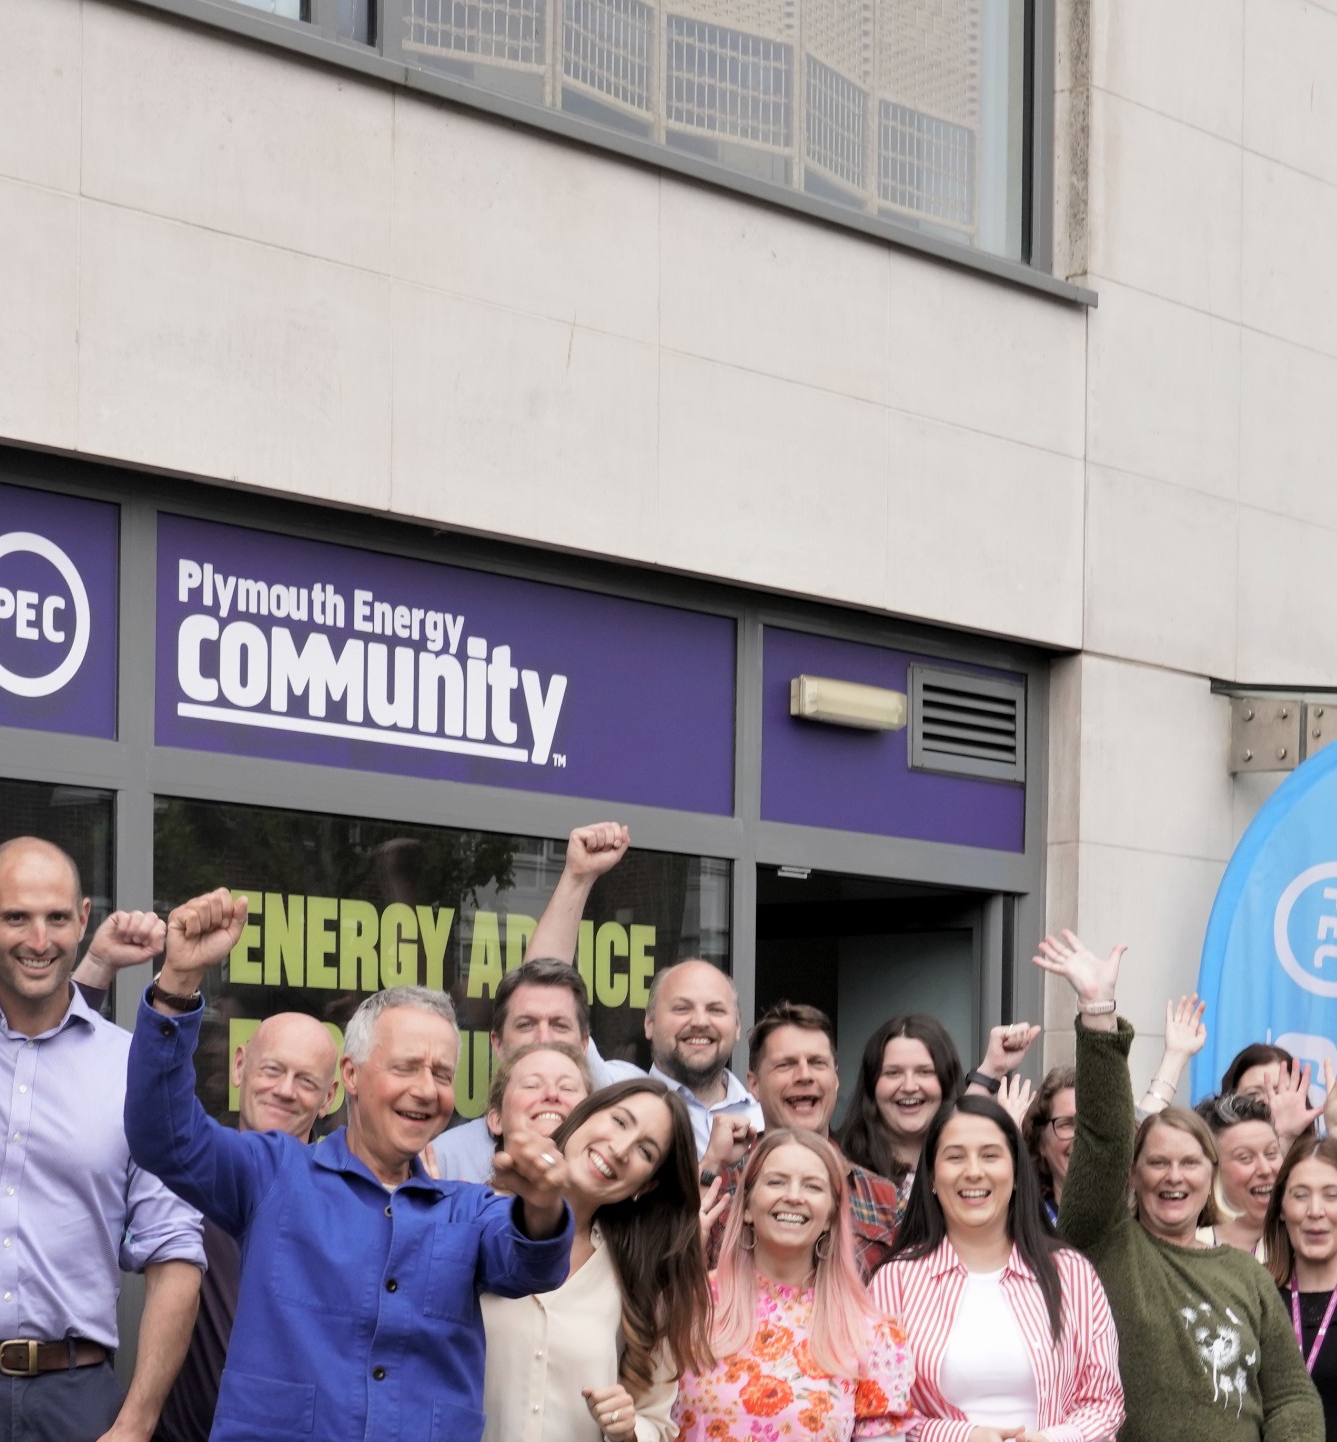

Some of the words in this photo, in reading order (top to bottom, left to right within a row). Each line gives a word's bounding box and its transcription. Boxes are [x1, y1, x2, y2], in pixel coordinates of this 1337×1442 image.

[178, 558, 345, 630] Plymouth
[353, 588, 465, 654] Energy
[228, 889, 455, 993] ENERGY
[466, 912, 657, 1009] ADICE
